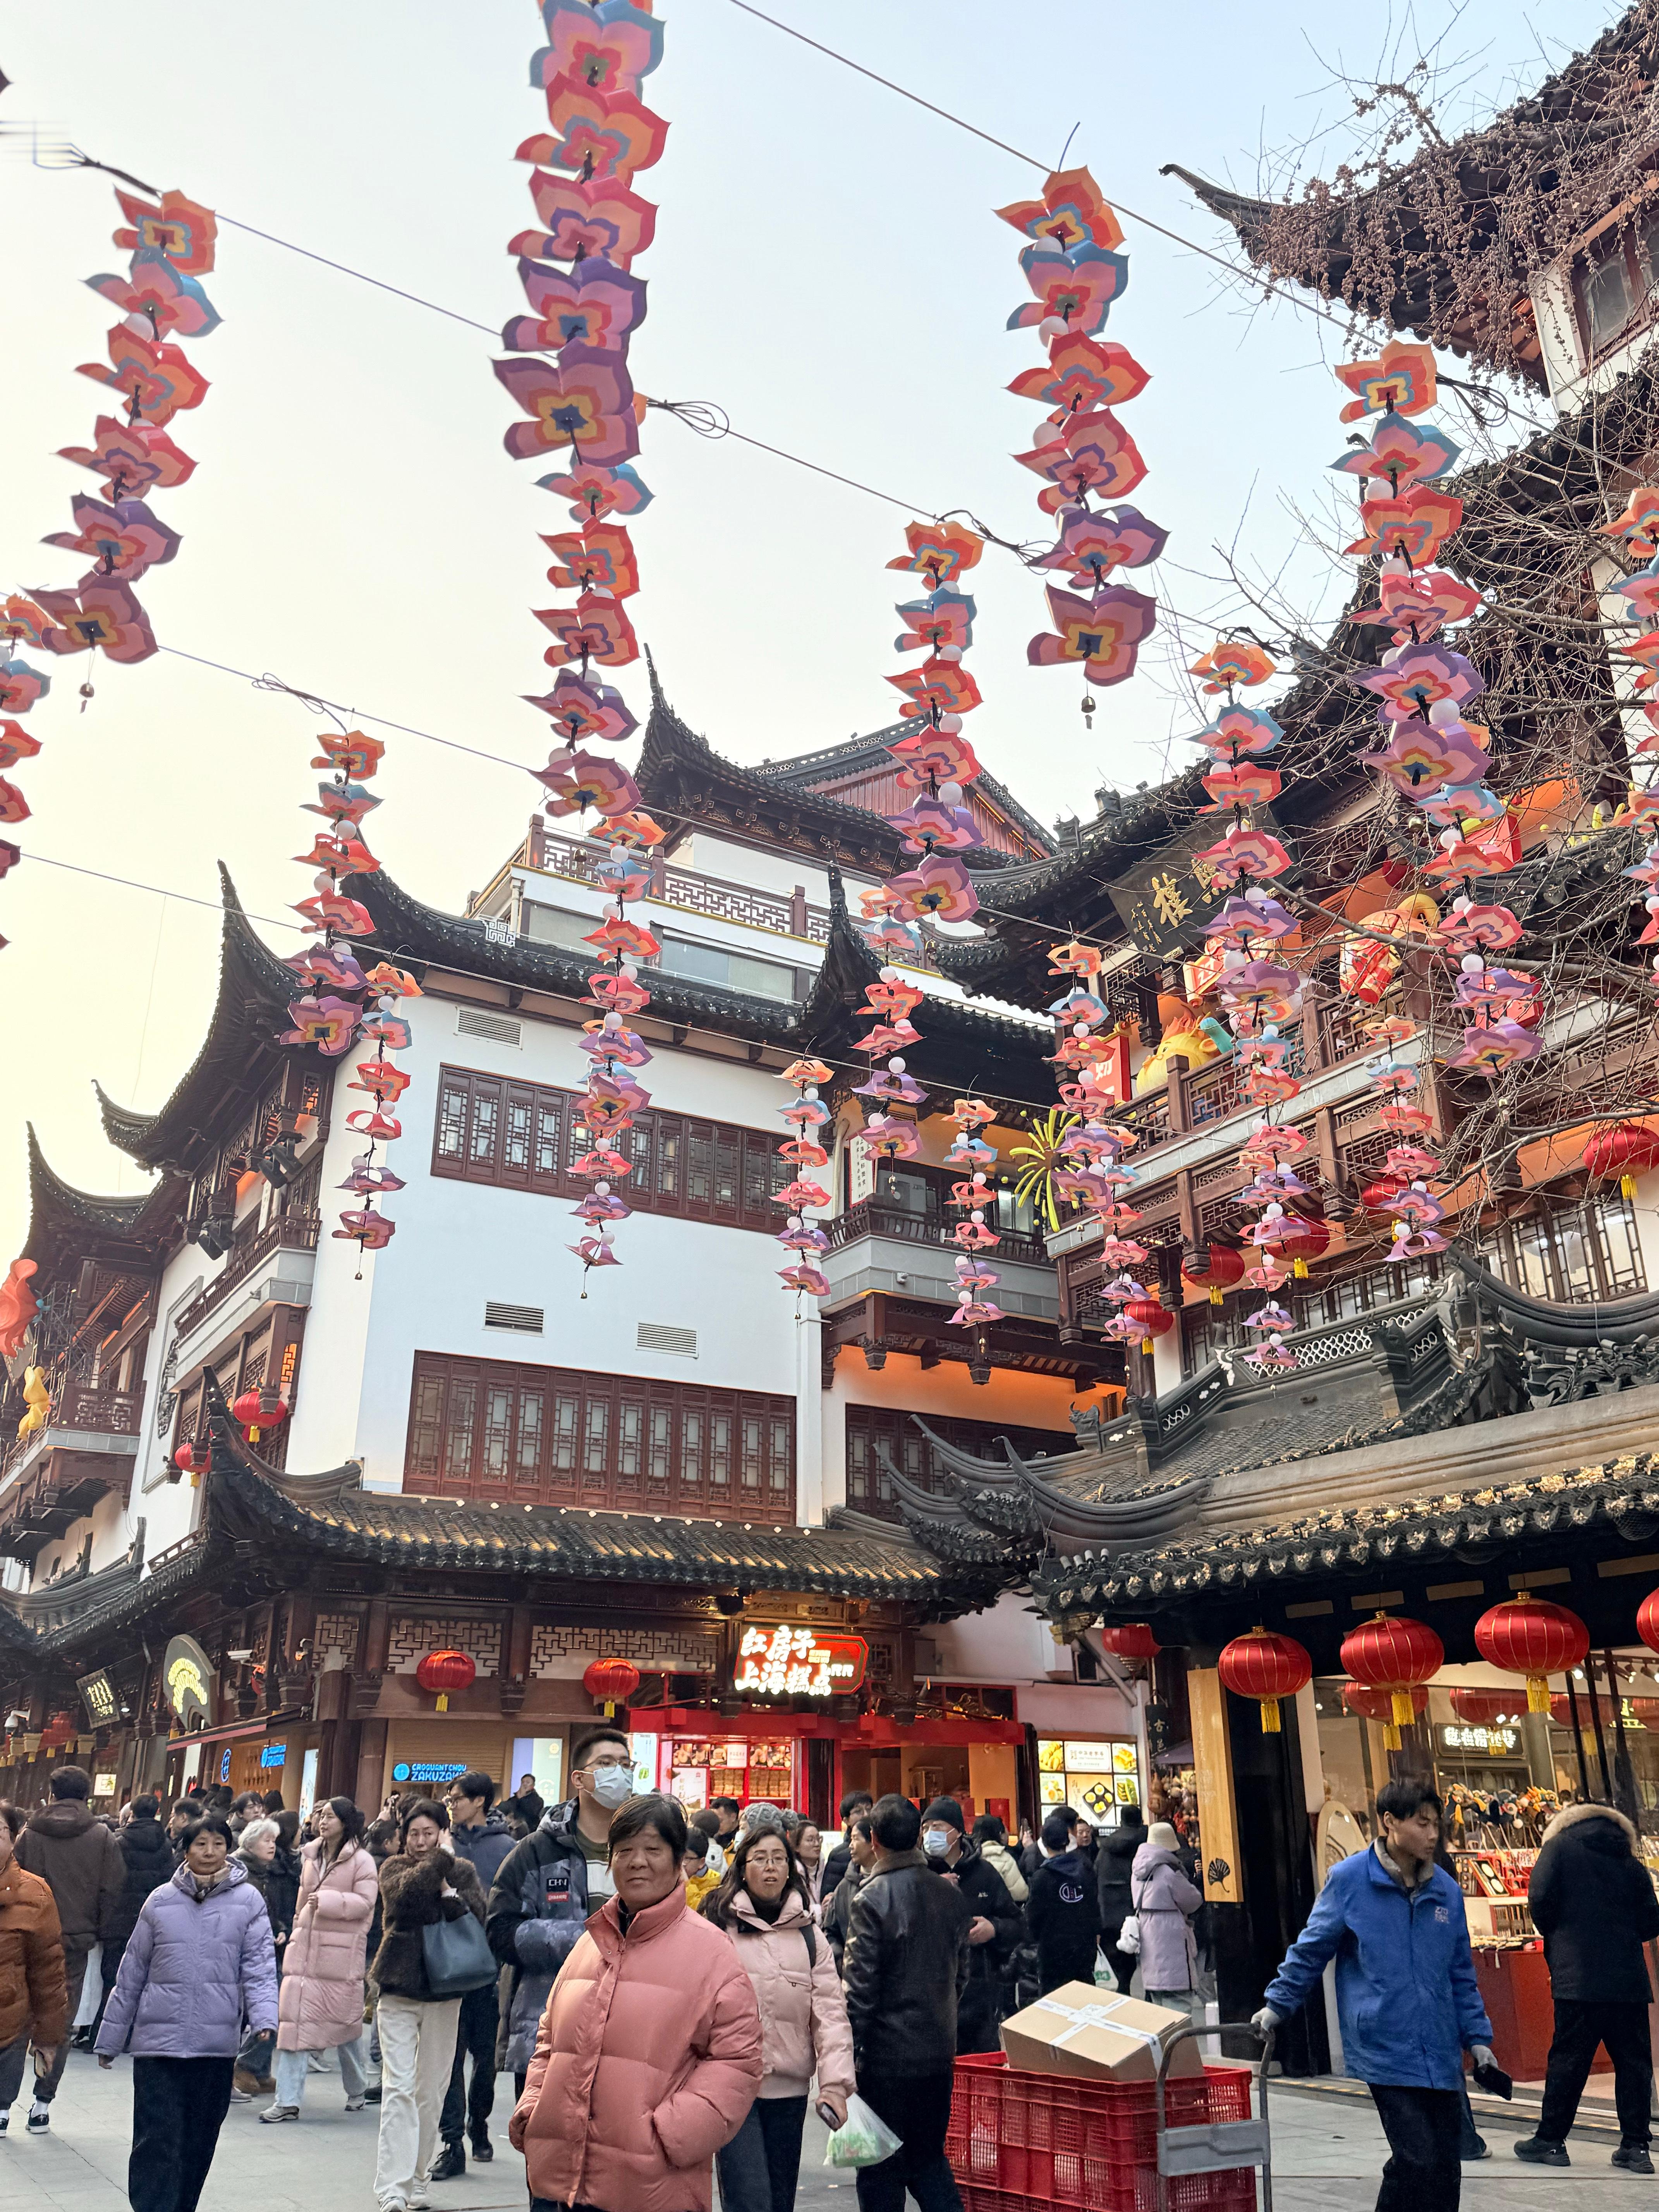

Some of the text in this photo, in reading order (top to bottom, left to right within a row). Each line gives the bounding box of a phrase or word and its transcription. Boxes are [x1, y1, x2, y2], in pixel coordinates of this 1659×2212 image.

[740, 1625, 816, 1662] 红房子
[735, 1661, 831, 1697] 上海糕点
[411, 1771, 463, 1782] ZAKUZAK
